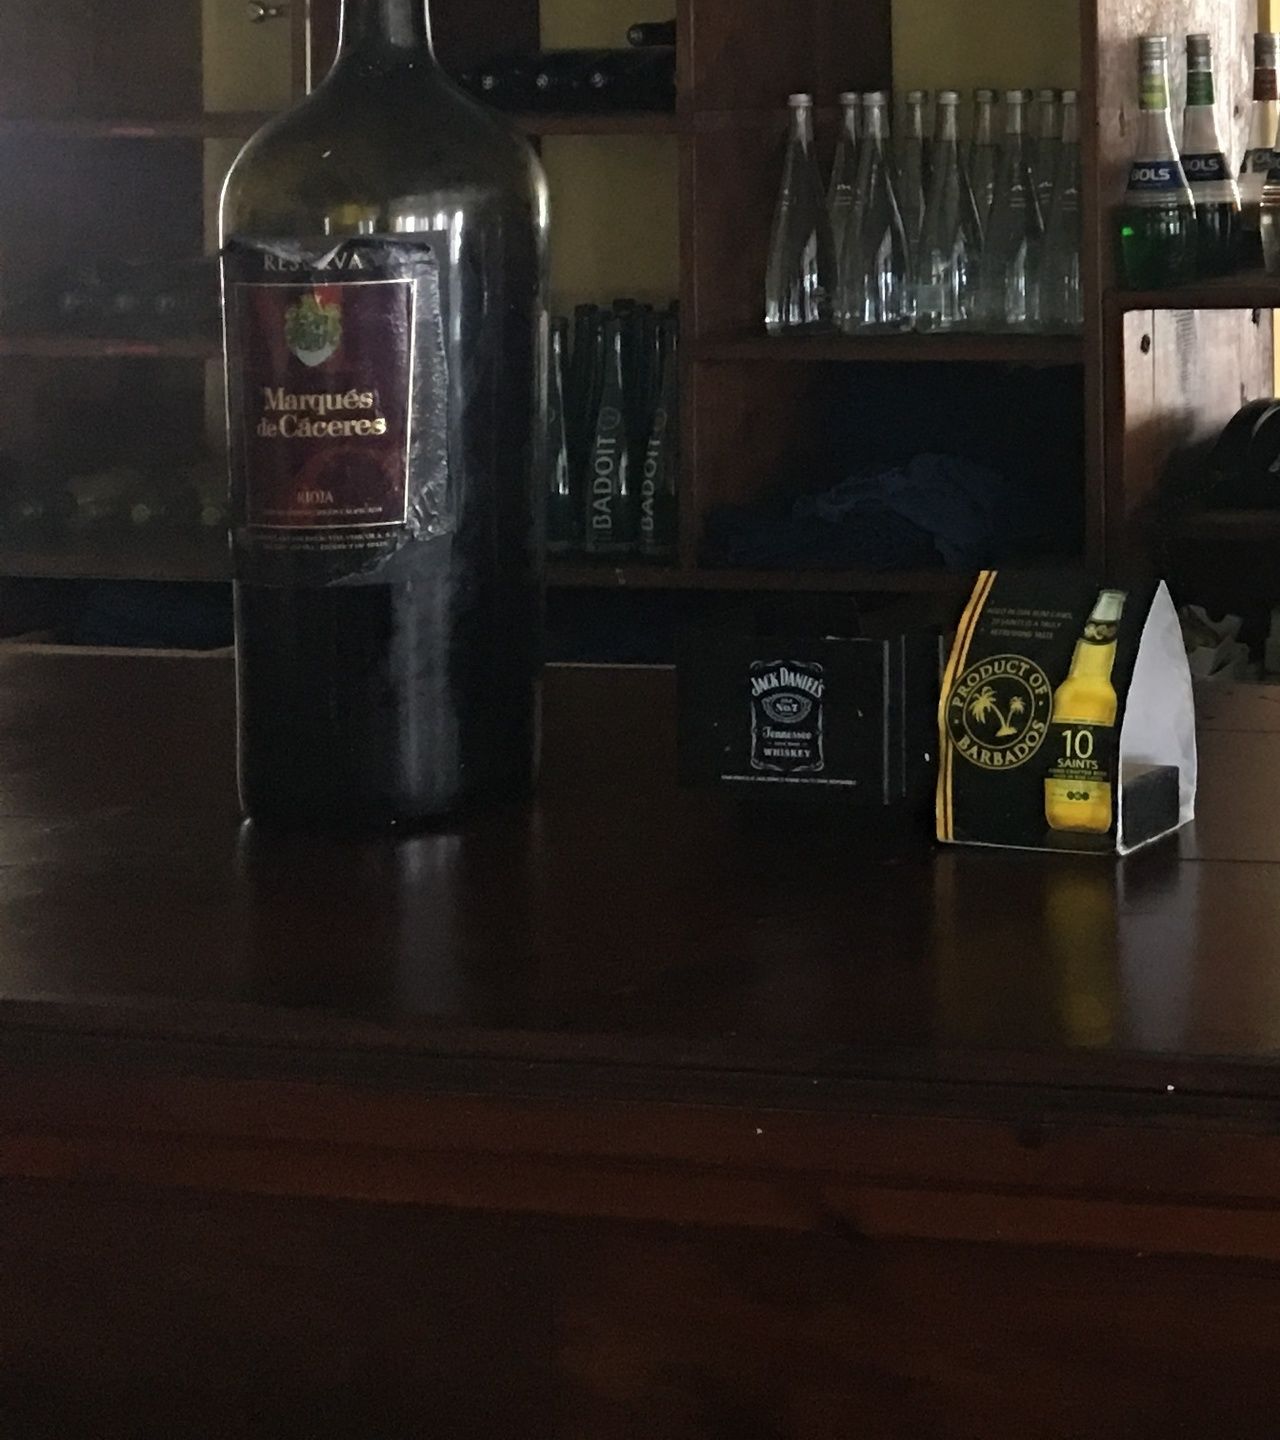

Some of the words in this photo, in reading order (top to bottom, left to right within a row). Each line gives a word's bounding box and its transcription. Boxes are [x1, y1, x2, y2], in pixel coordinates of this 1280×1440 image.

[263, 388, 373, 415] Marqués
[257, 416, 279, 438] de
[279, 414, 389, 438] Cáceres
[298, 490, 335, 504] RIOJA
[593, 435, 617, 530] BADOIT
[641, 440, 661, 531] BADOIT
[750, 671, 780, 698] JACK
[779, 666, 826, 699] DANIEL'S
[952, 659, 1031, 709] PRODUCT
[1028, 670, 1050, 696] OF
[763, 747, 812, 759] WHISKEY
[956, 724, 1046, 766] BARBADOS
[1061, 729, 1094, 759] 10
[1057, 757, 1099, 770] SAINTS
